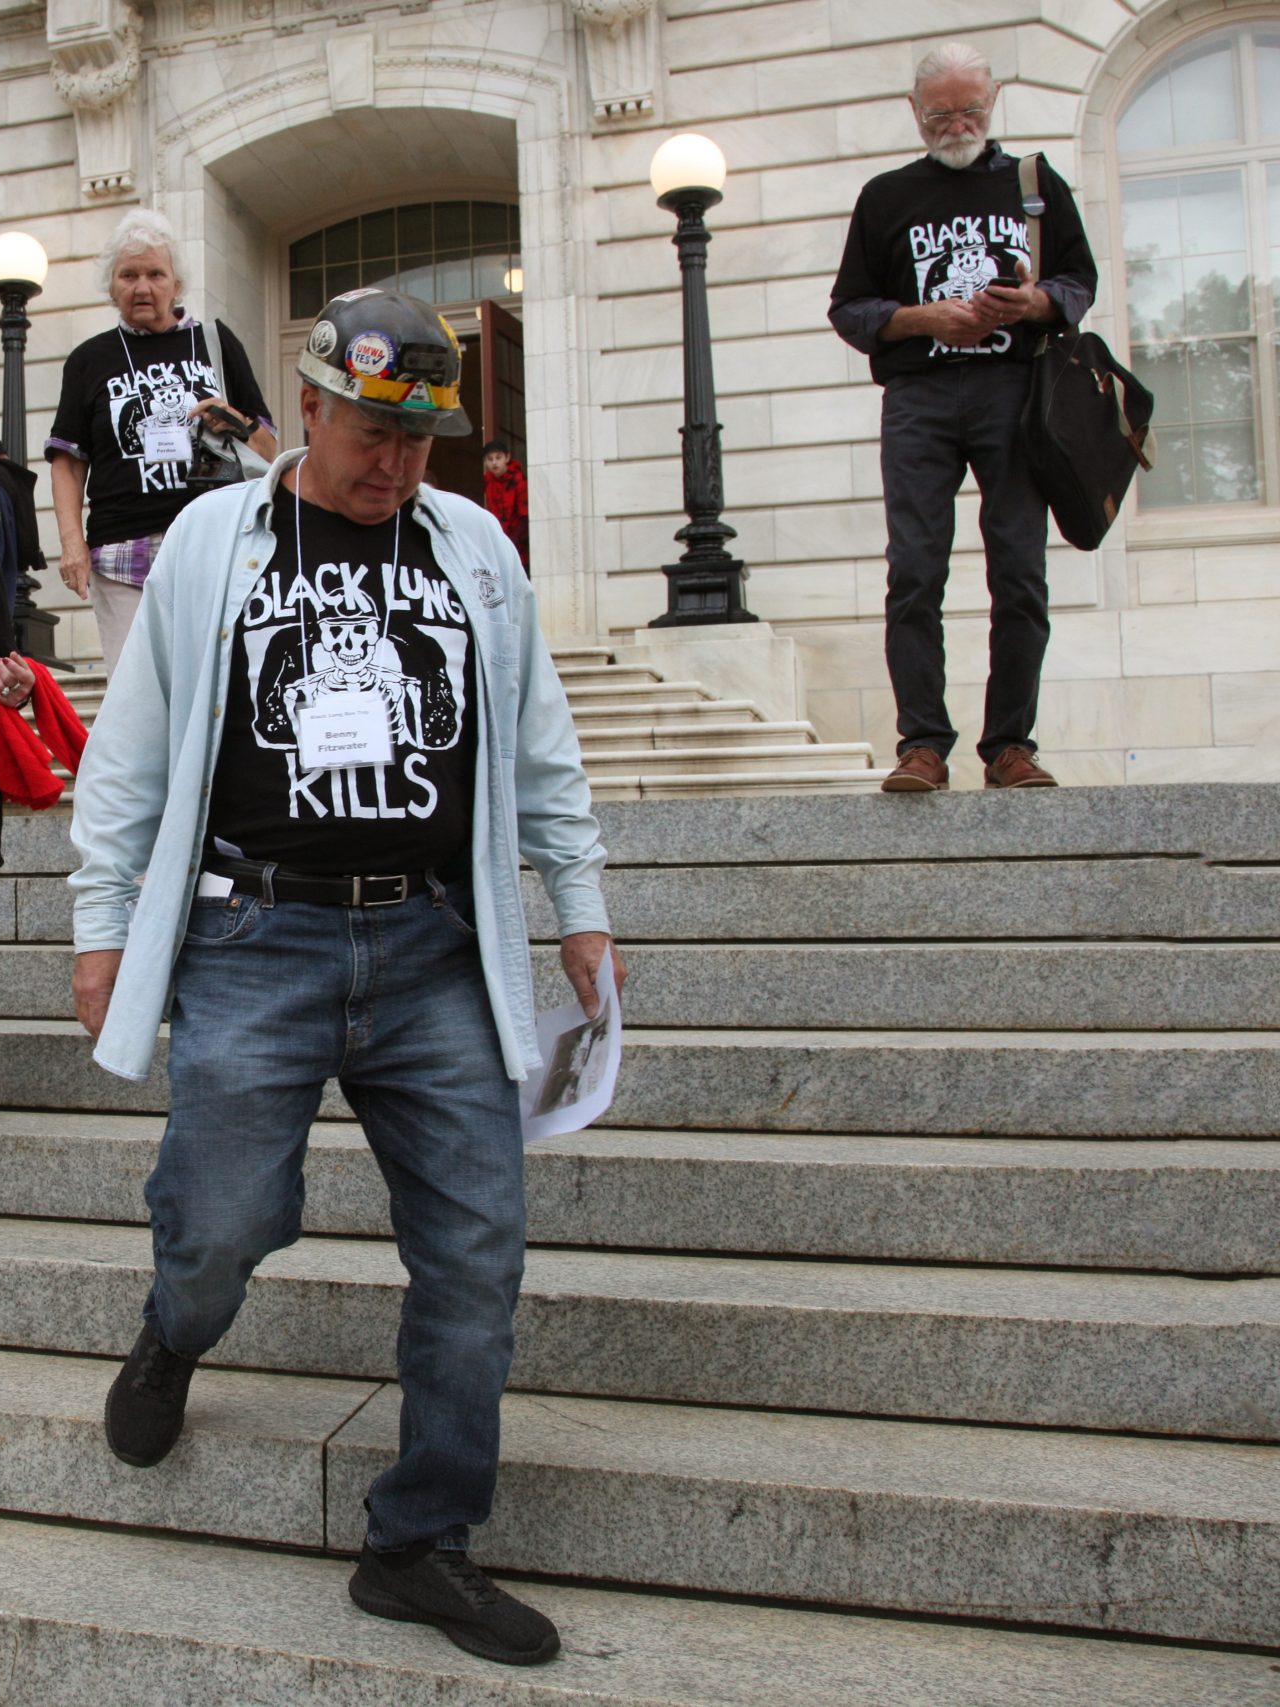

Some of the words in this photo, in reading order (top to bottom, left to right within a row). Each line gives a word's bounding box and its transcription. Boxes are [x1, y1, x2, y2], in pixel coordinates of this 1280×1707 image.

[909, 216, 983, 260] BLACK
[355, 353, 370, 364] YES
[357, 344, 384, 358] UMWA
[107, 362, 175, 400] BLACK
[138, 457, 191, 493] KIL
[243, 562, 374, 627] BLACK
[381, 563, 466, 624] LUNG
[318, 741, 368, 753] Fitzwater
[325, 730, 358, 740] Benny
[285, 752, 438, 819] KILLS
